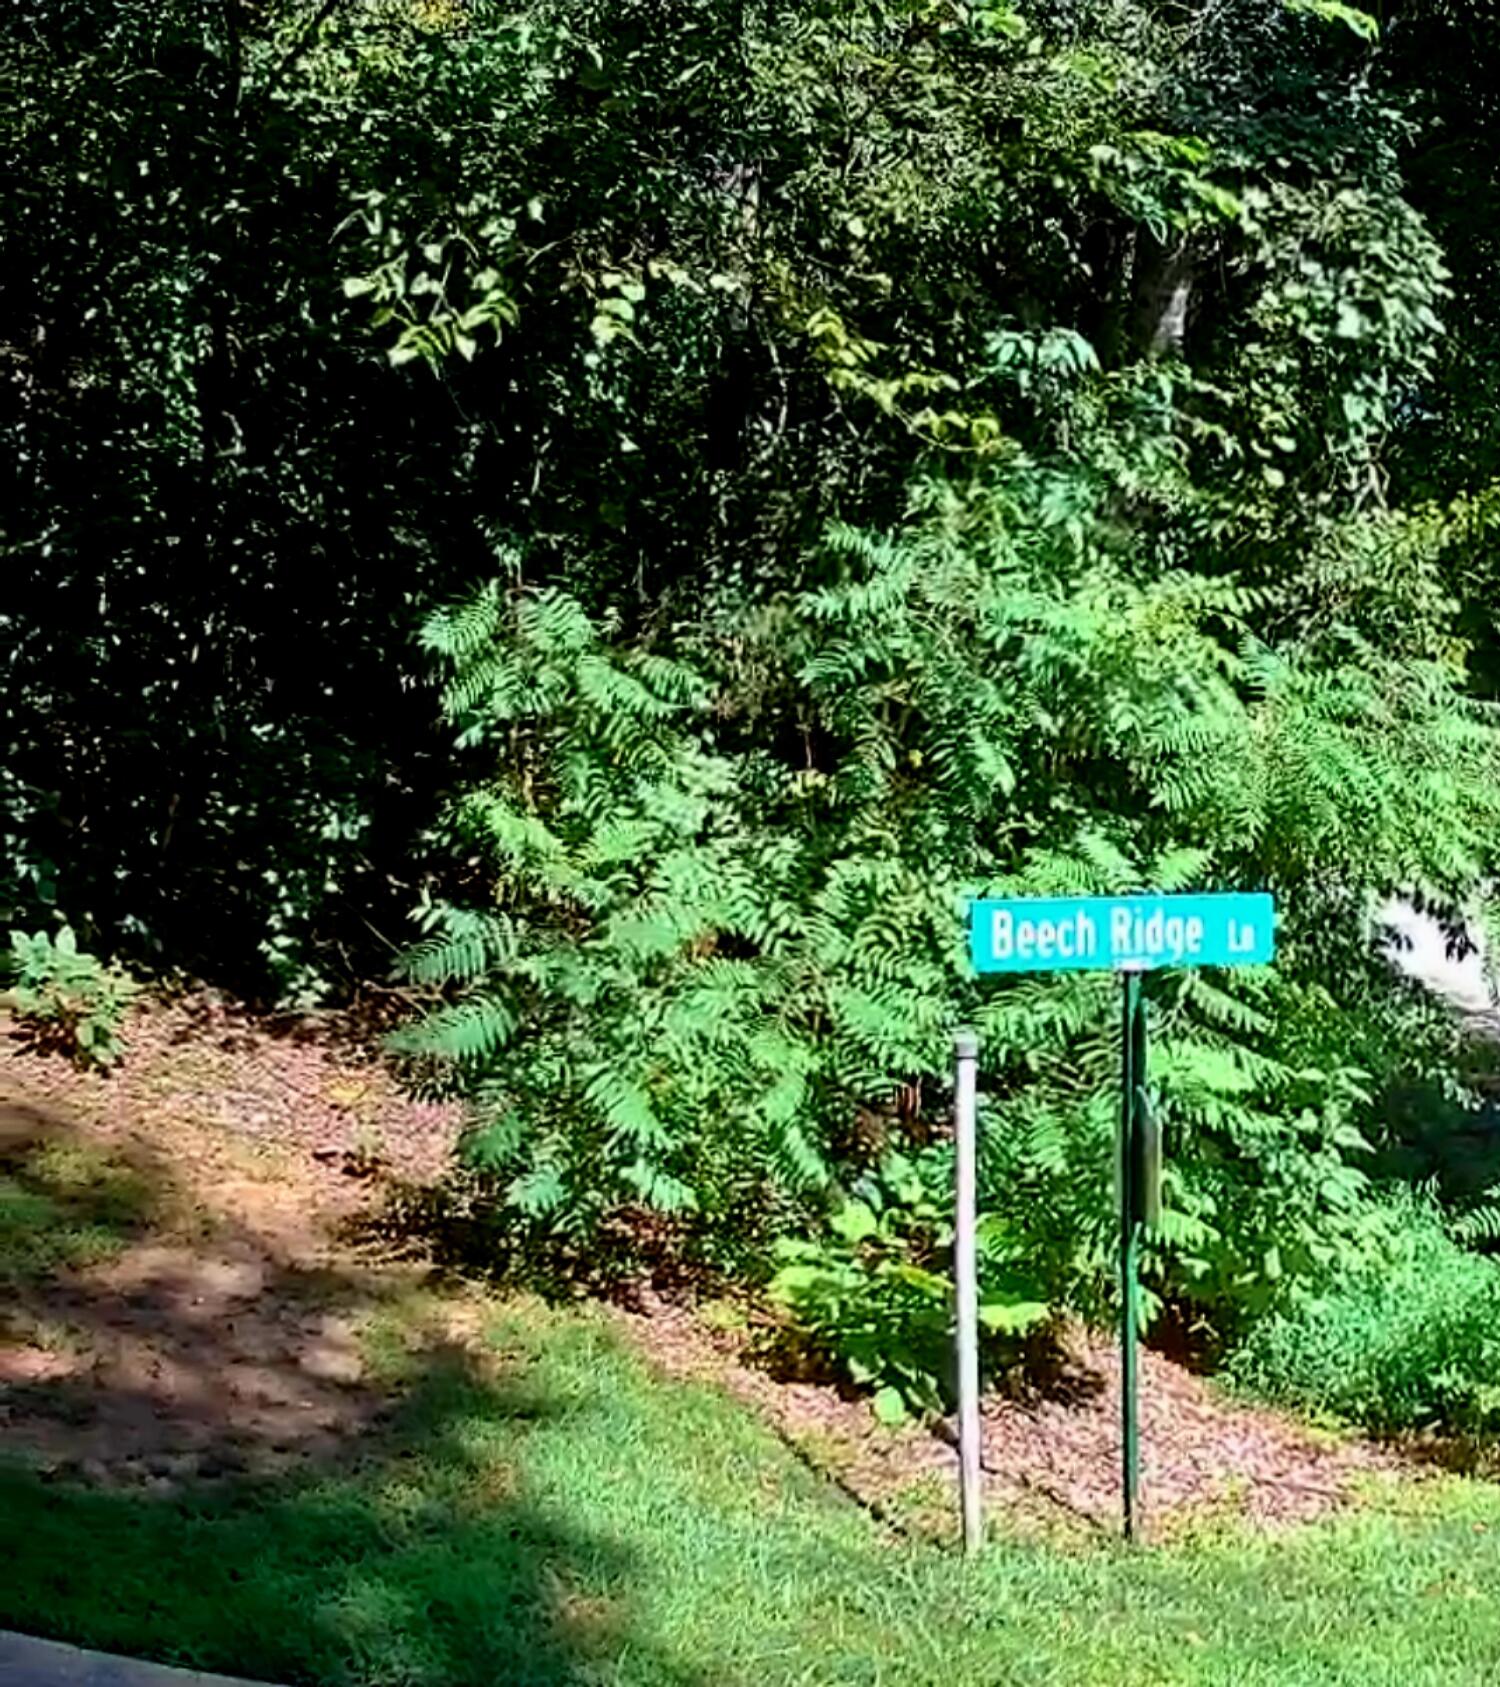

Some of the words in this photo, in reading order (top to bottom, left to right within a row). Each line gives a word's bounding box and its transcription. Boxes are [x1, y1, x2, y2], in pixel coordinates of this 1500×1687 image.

[991, 908, 1096, 960] Beech
[1110, 906, 1204, 960] Ridge
[1227, 918, 1255, 951] Ln
